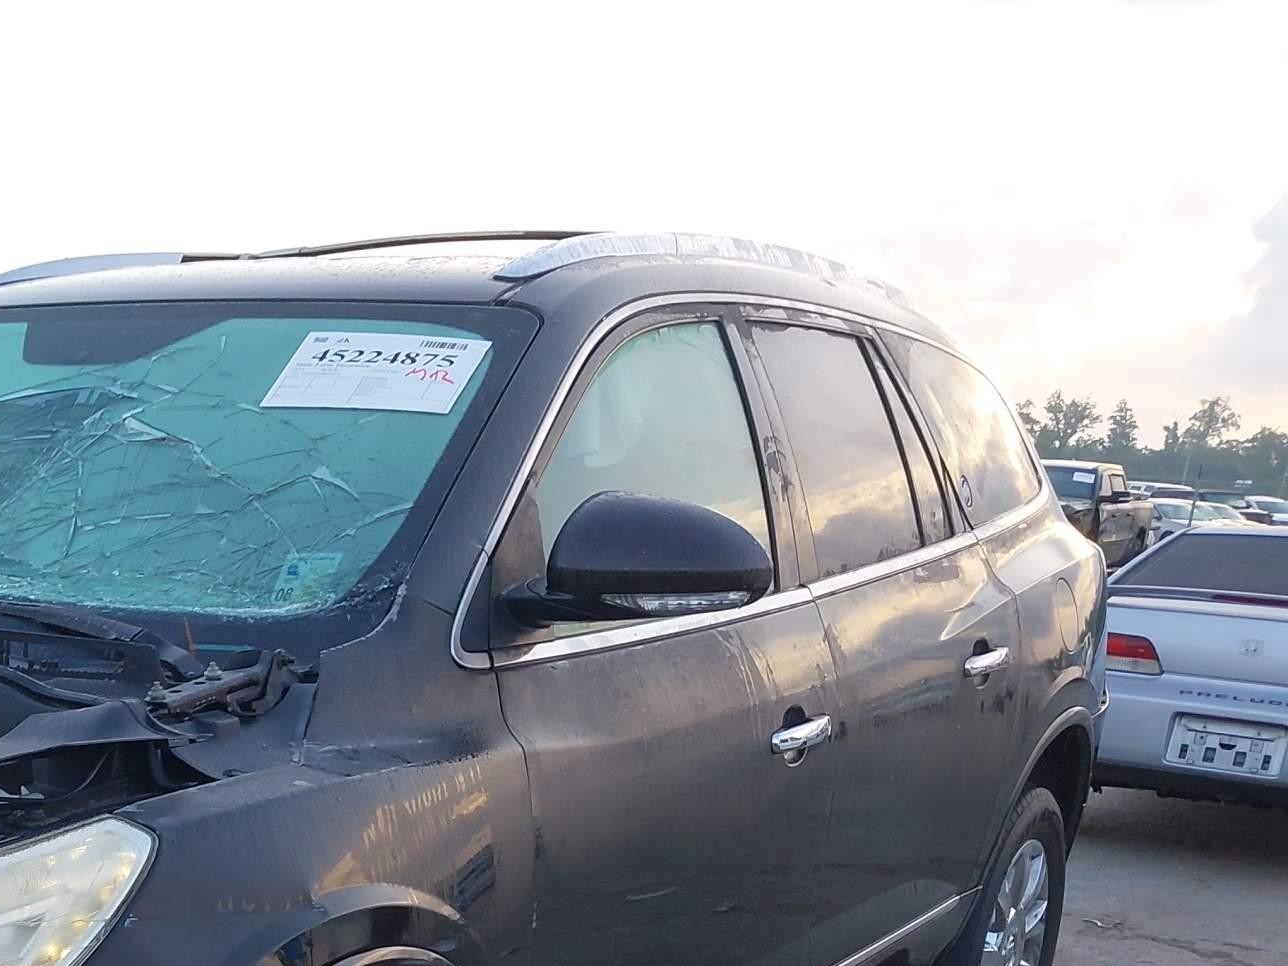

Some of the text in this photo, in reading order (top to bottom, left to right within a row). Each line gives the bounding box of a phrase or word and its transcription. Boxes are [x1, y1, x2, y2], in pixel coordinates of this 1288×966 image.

[311, 348, 459, 368] 45224875
[274, 587, 295, 602] 08
[1179, 689, 1288, 708] PRELUD
